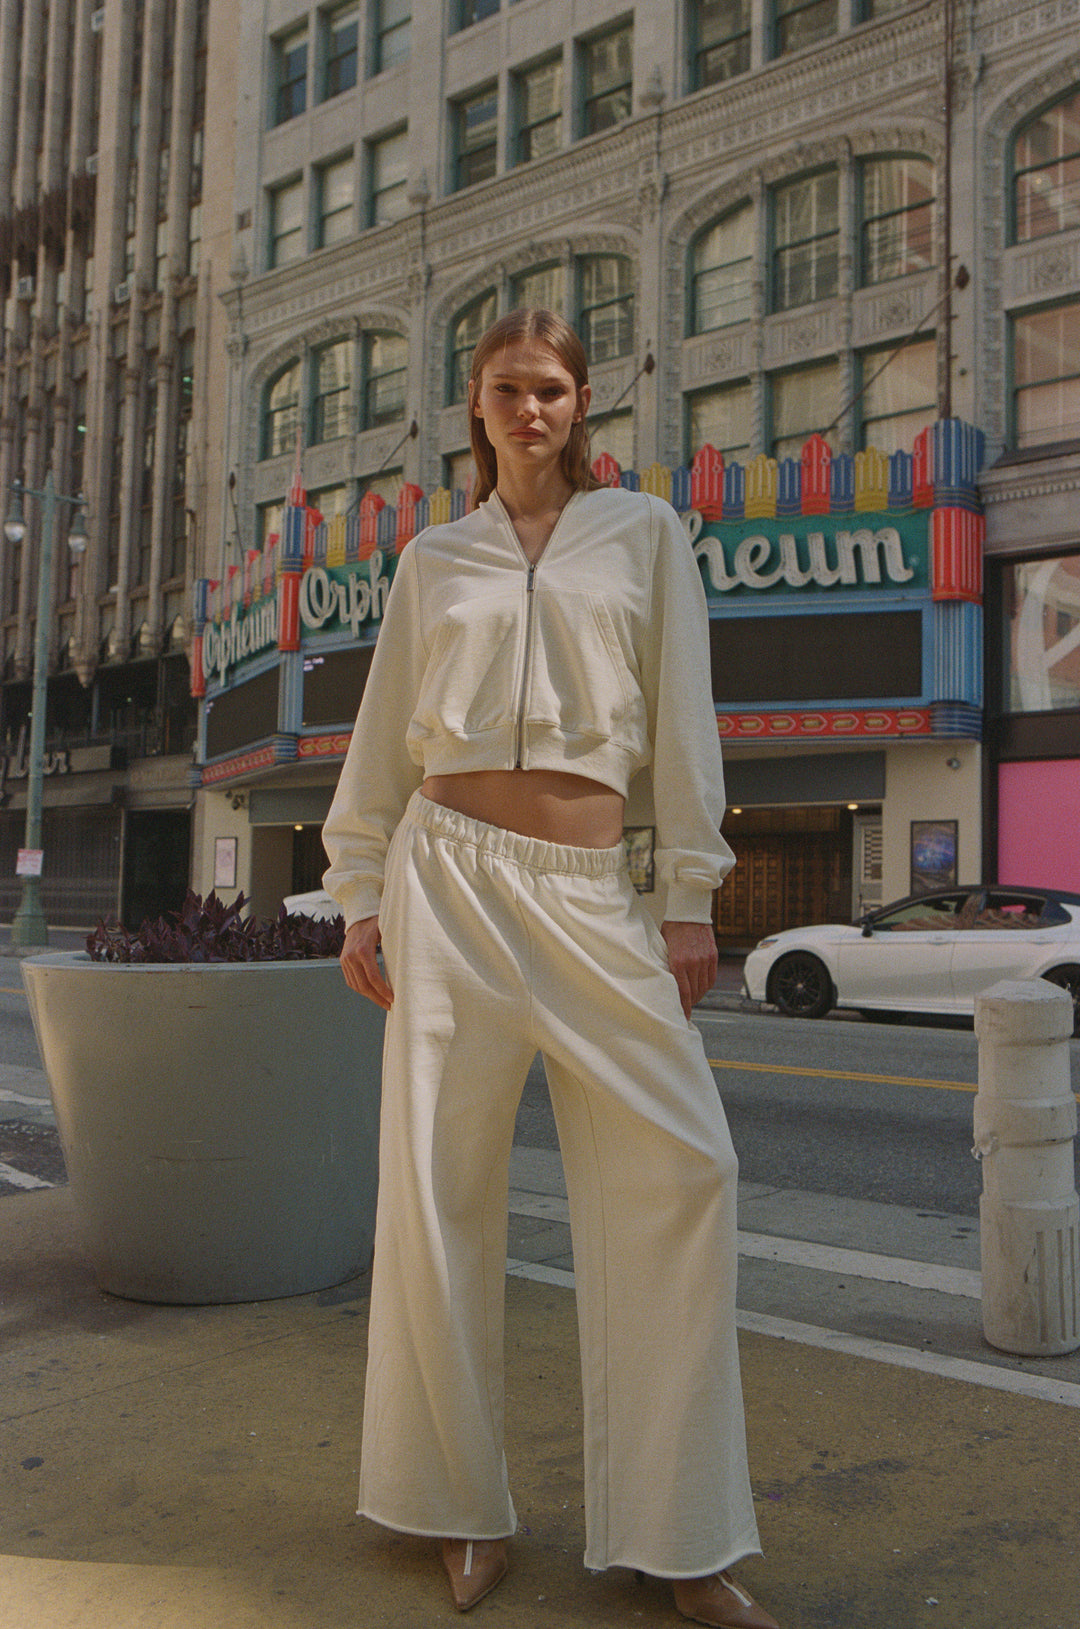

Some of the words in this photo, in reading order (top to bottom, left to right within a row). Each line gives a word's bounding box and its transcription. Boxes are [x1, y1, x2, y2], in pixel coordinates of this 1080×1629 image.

[299, 549, 389, 638] Orph
[681, 508, 915, 592] heum
[202, 599, 278, 687] Orpheum
